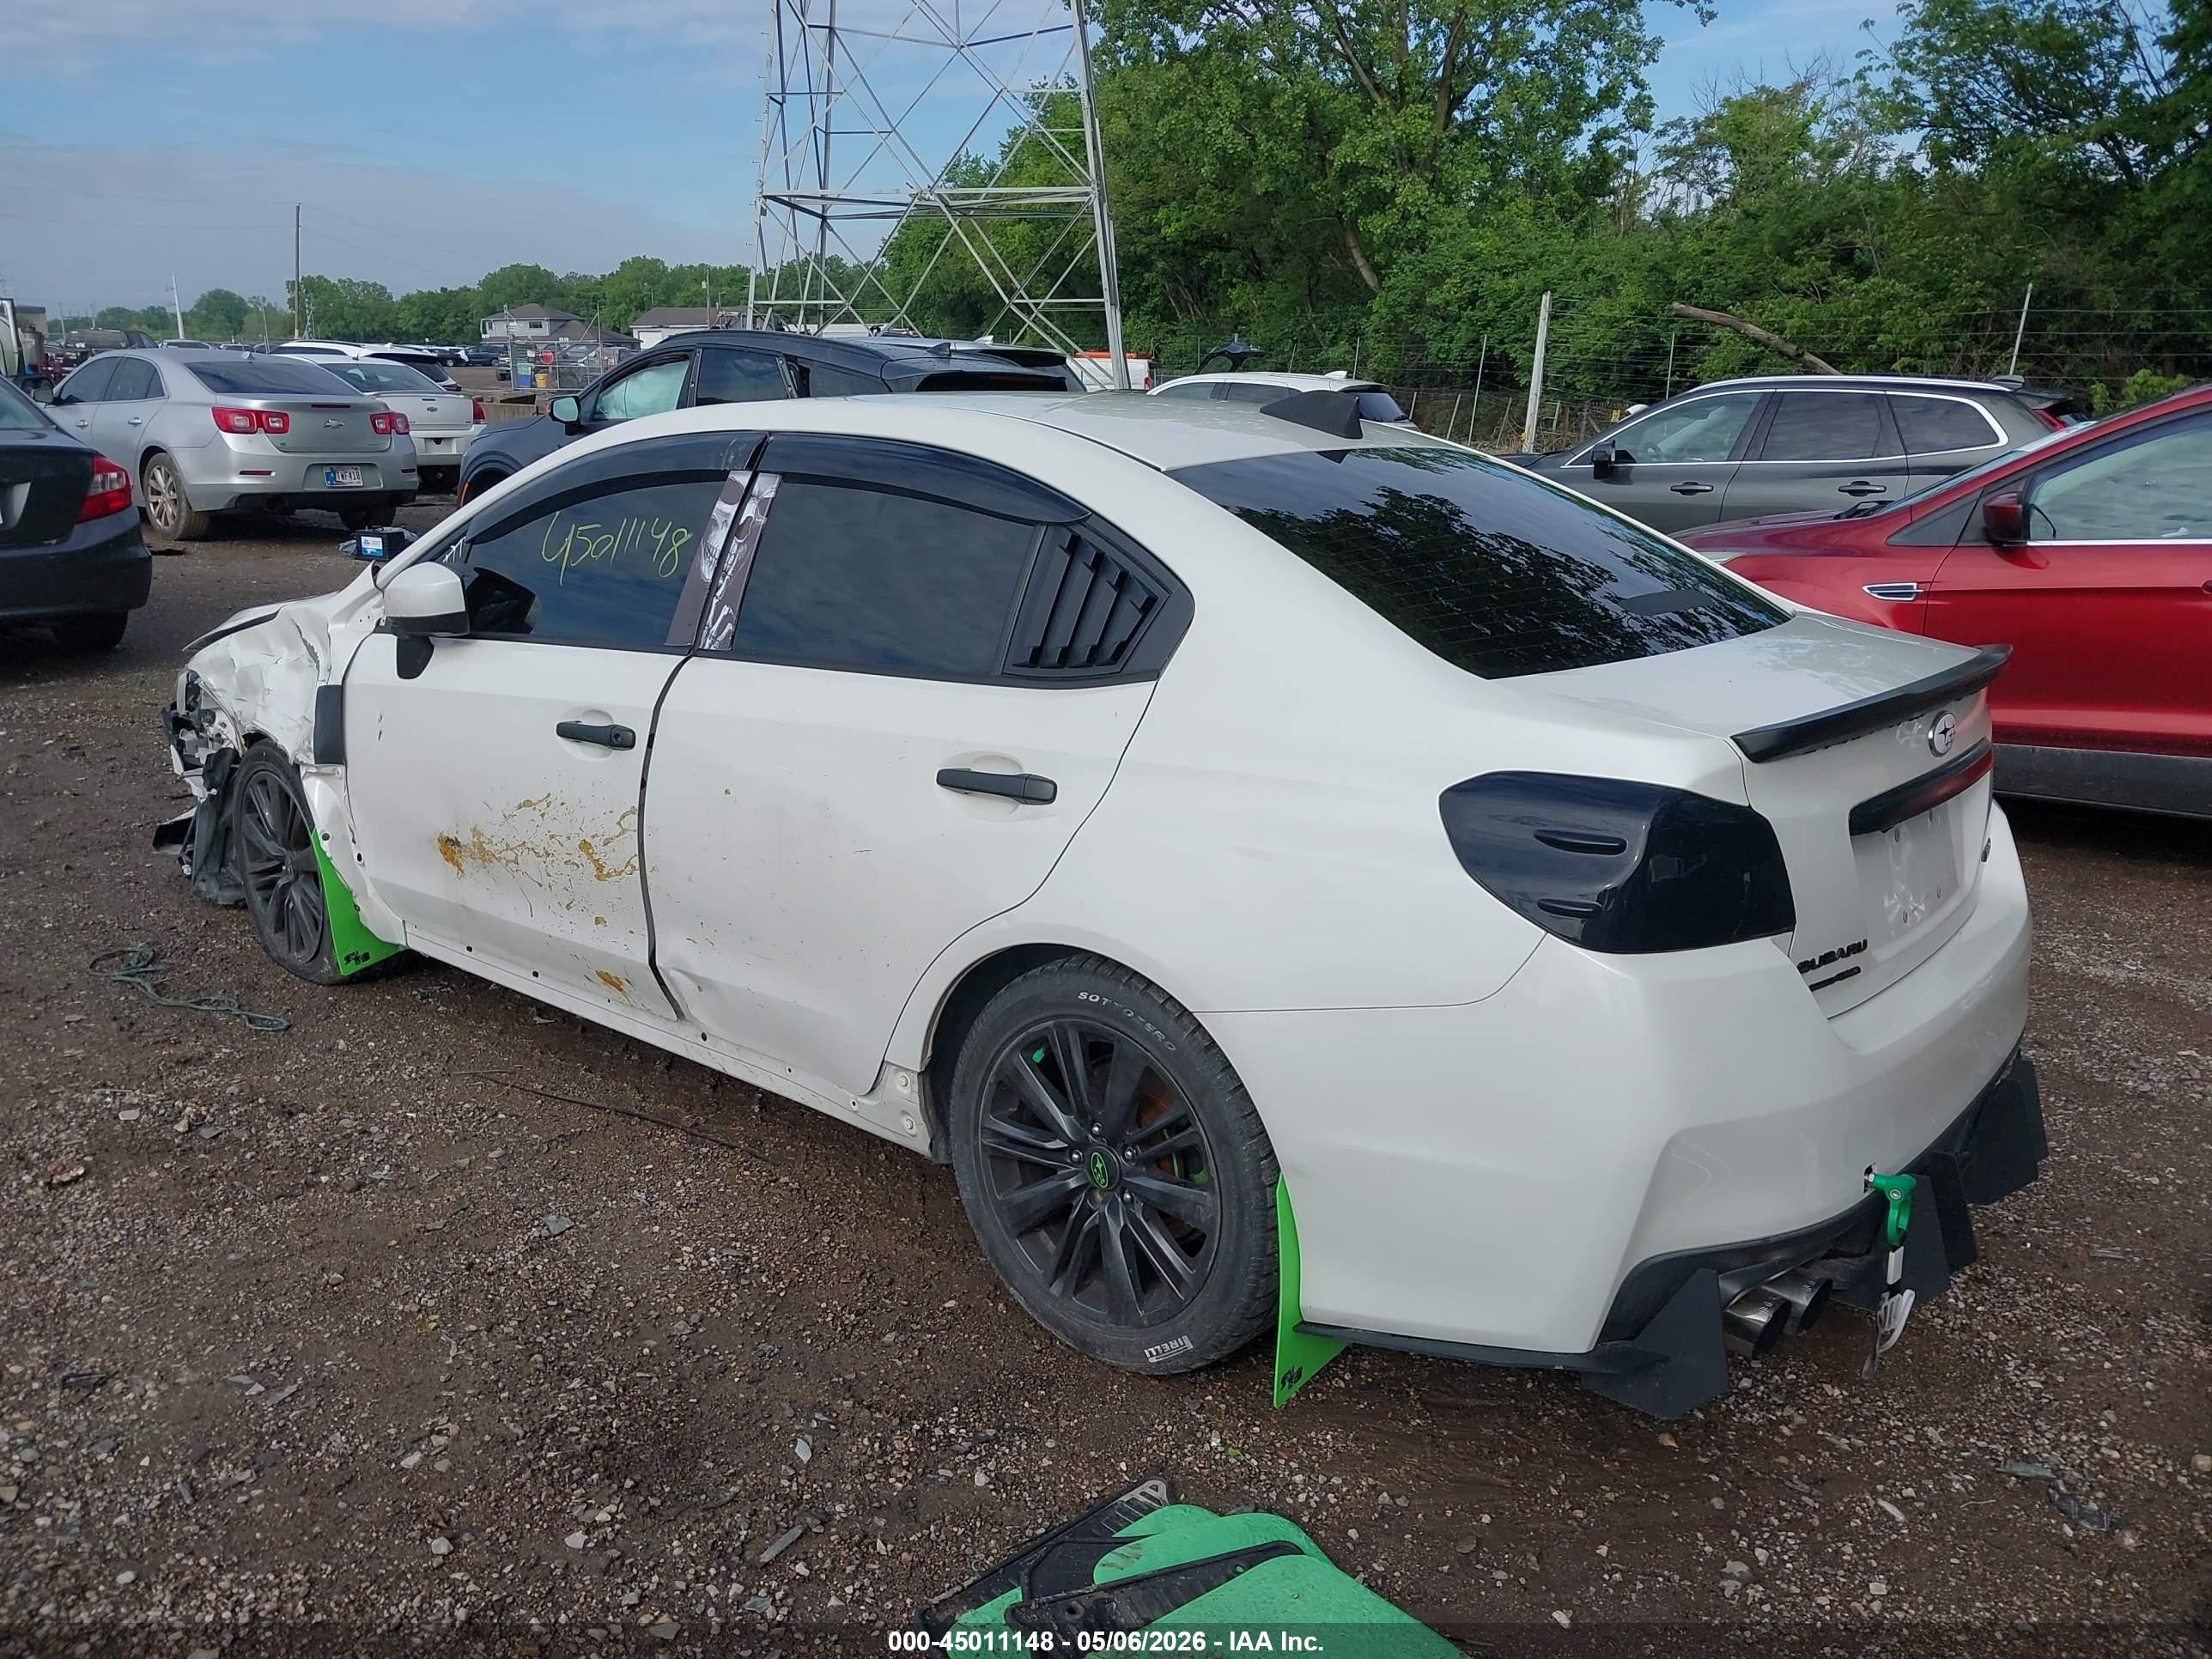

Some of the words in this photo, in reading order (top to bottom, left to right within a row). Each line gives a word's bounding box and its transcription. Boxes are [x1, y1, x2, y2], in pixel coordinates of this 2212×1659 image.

[541, 510, 694, 587] 45011148
[1796, 939, 1869, 975] SUBARU
[1143, 1334, 1194, 1364] PIRELLI
